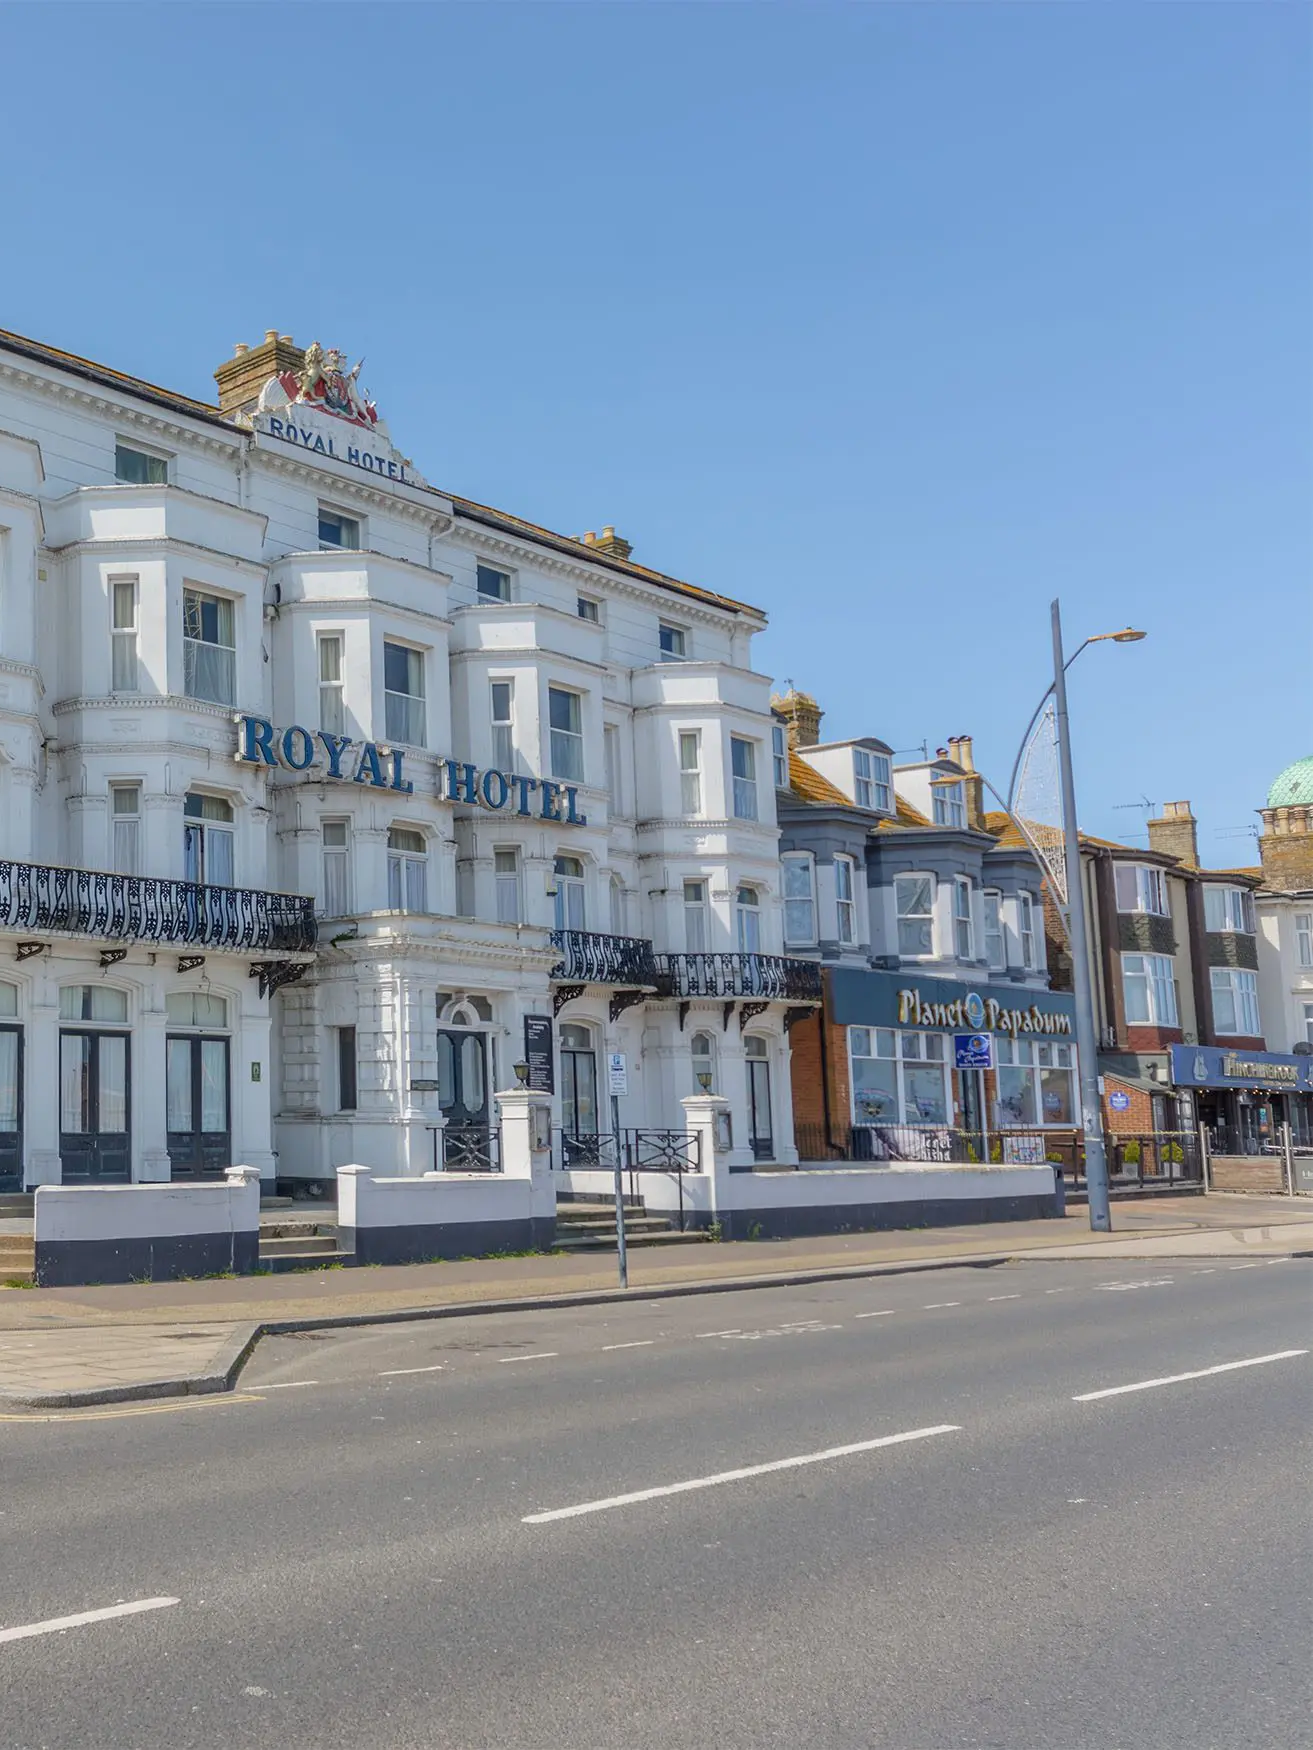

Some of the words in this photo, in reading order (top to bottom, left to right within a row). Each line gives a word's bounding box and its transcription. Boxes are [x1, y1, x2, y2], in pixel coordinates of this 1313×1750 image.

[271, 417, 339, 459] ROYAL
[240, 715, 414, 794] ROYAL
[444, 759, 587, 827] HOTEL
[898, 988, 964, 1028] Planet
[986, 998, 1072, 1039] Papadum
